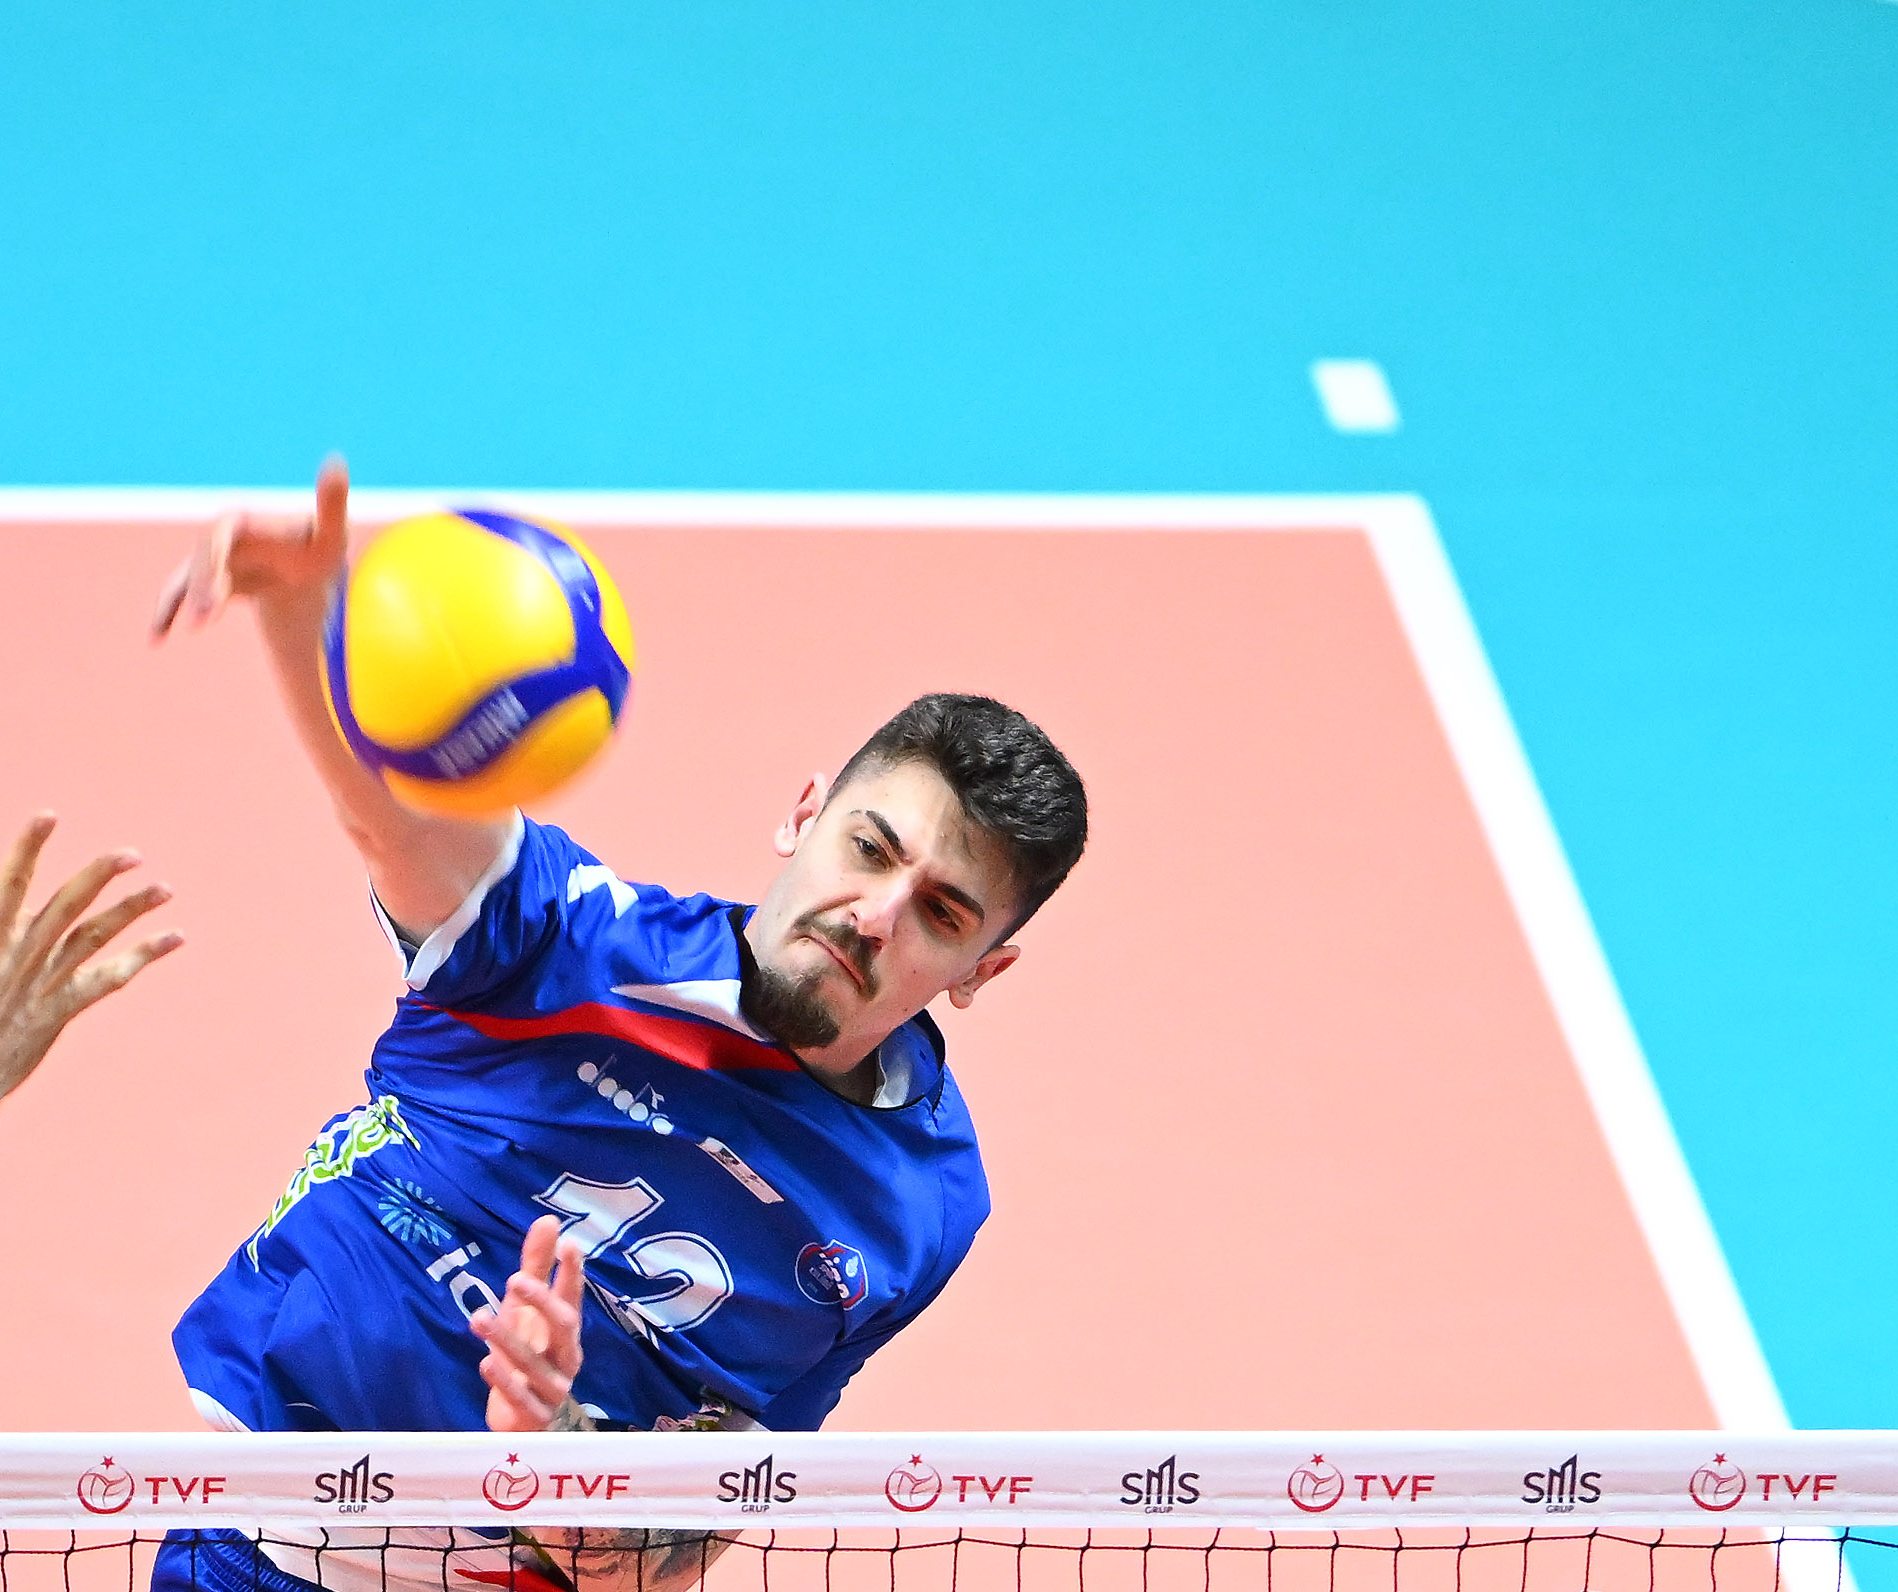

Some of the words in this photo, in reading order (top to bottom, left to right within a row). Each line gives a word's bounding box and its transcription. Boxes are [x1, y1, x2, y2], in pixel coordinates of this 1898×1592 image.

[144, 1476, 227, 1505] TVF
[313, 1453, 395, 1504] SMS
[549, 1474, 631, 1504] TVF
[717, 1454, 797, 1504] SMS
[952, 1475, 1034, 1505] TVF
[1120, 1454, 1201, 1505] SMS
[1354, 1474, 1435, 1504] TVF
[1522, 1454, 1602, 1505] SMS
[1757, 1474, 1837, 1504] TVF
